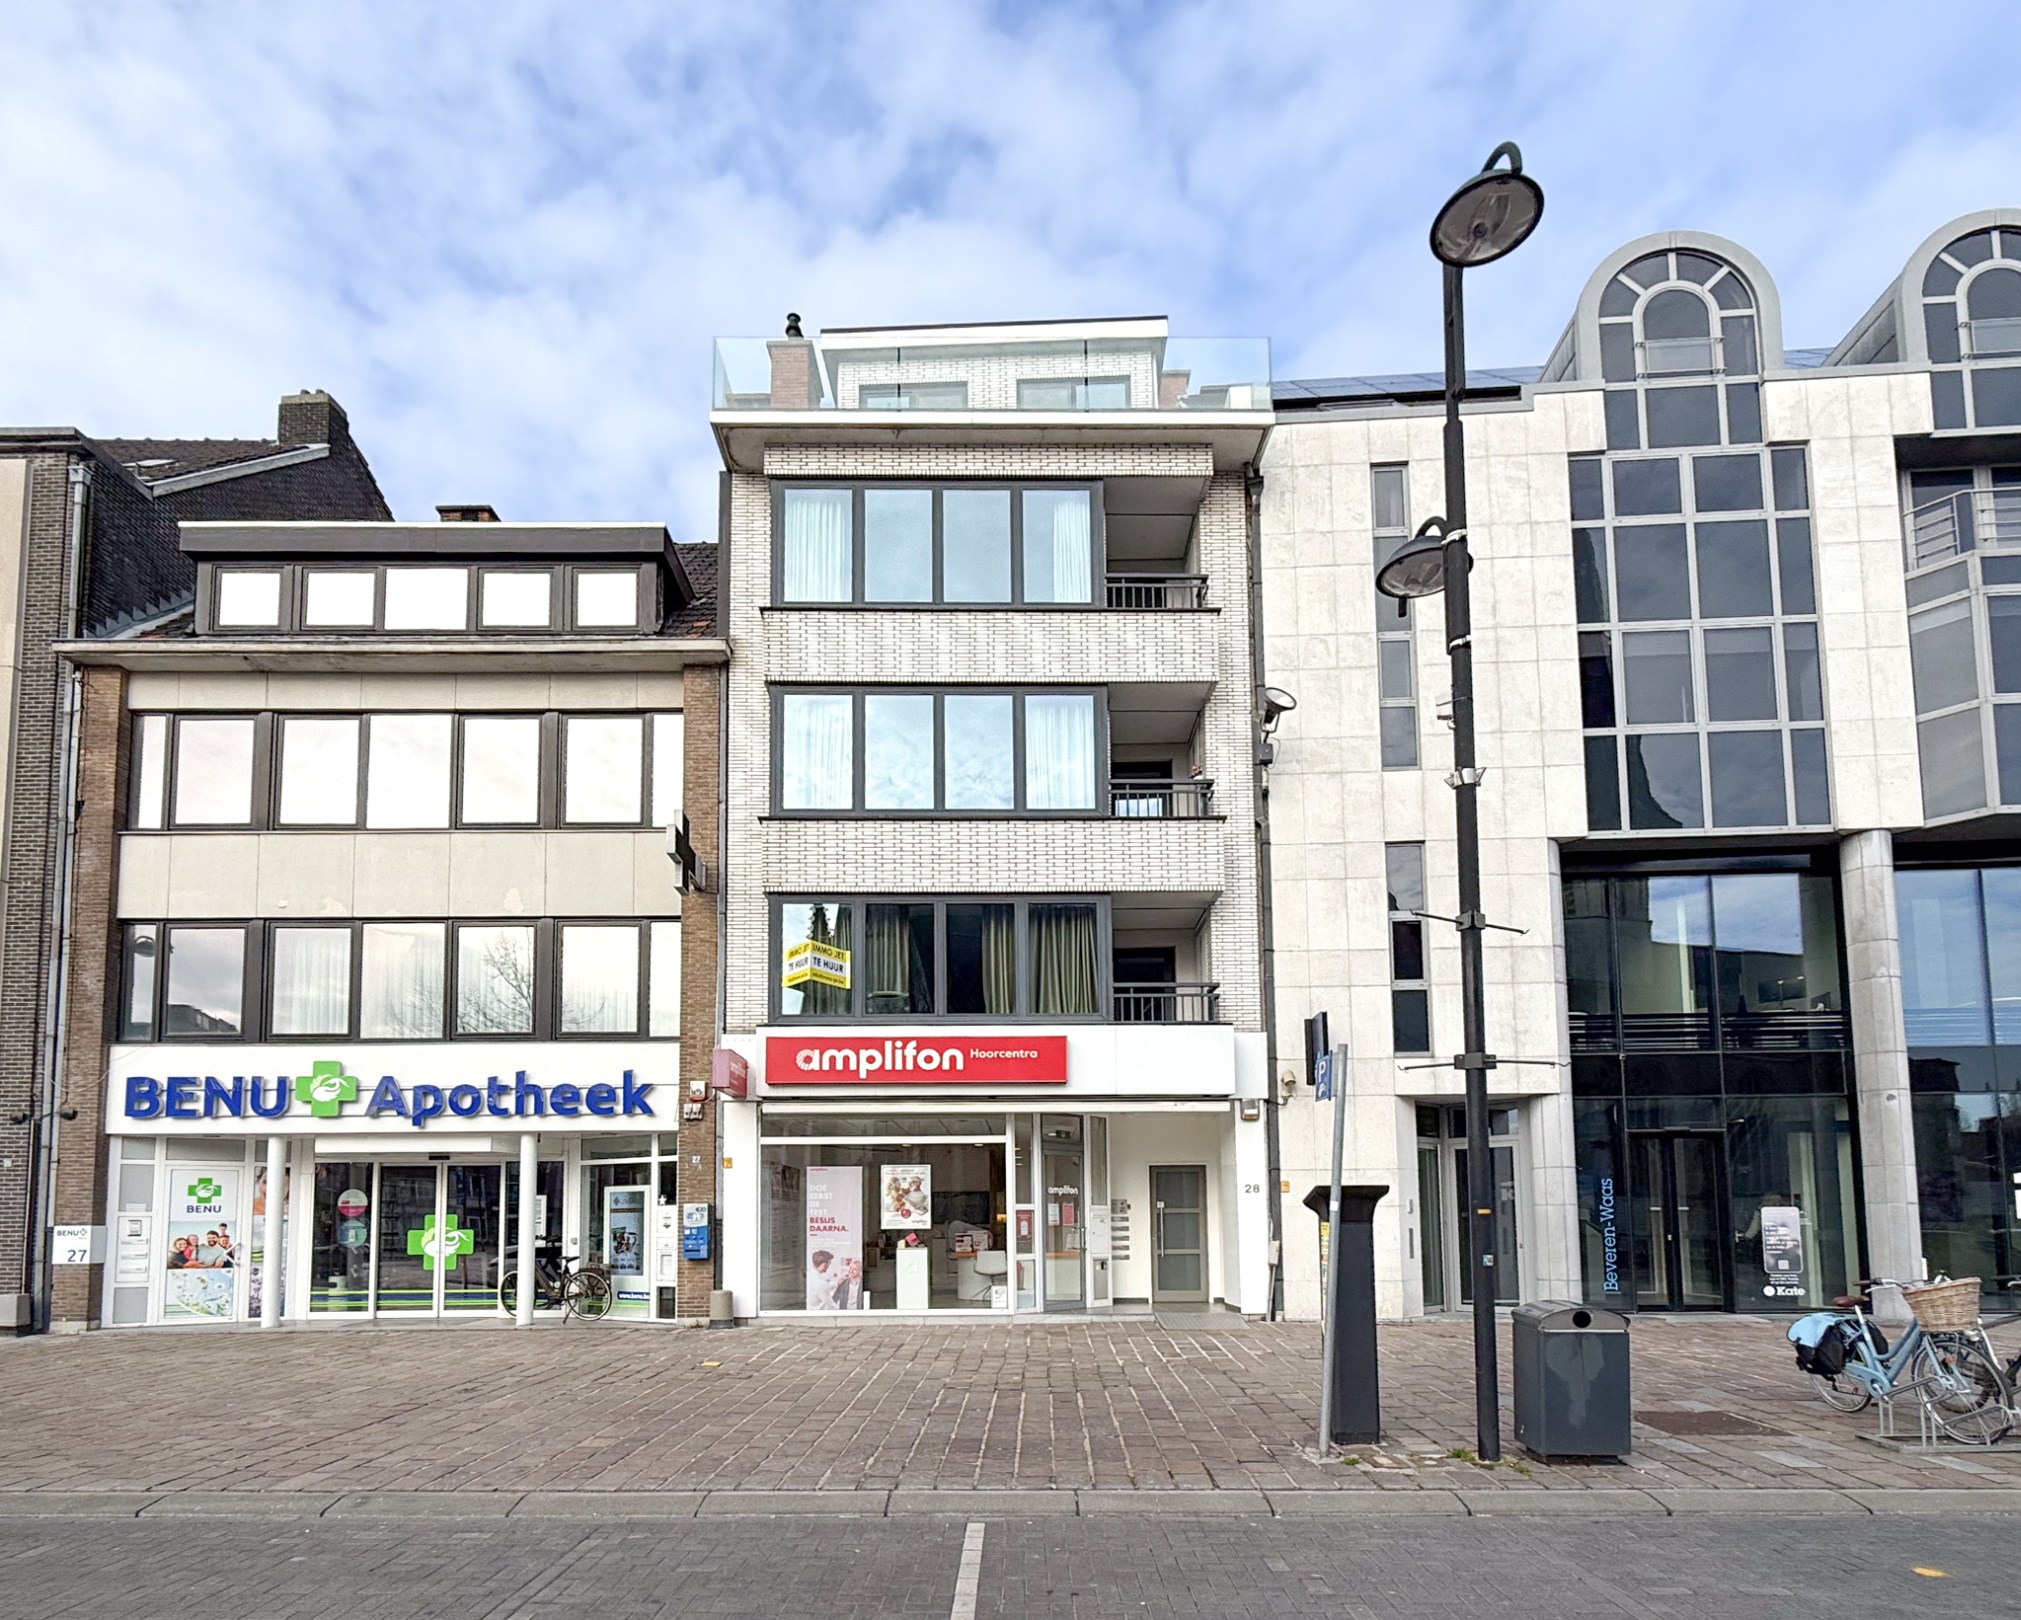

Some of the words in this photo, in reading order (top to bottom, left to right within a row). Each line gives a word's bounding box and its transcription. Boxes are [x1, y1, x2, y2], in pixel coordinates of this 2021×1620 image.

[813, 956, 822, 967] TE
[823, 961, 844, 973] HUUR
[796, 1040, 964, 1079] amplifon
[970, 1048, 1038, 1059] Hoorcentra
[1318, 1061, 1327, 1083] P
[124, 1075, 291, 1119] BENU
[364, 1069, 655, 1127] Apotheek
[1047, 1185, 1079, 1196] amplifon
[1244, 1184, 1260, 1194] 28
[186, 1205, 222, 1213] BENU
[56, 1229, 79, 1237] BENU
[1599, 1178, 1619, 1291] Beveren-Waas
[67, 1249, 88, 1263] 27
[1776, 1286, 1806, 1296] Kate
